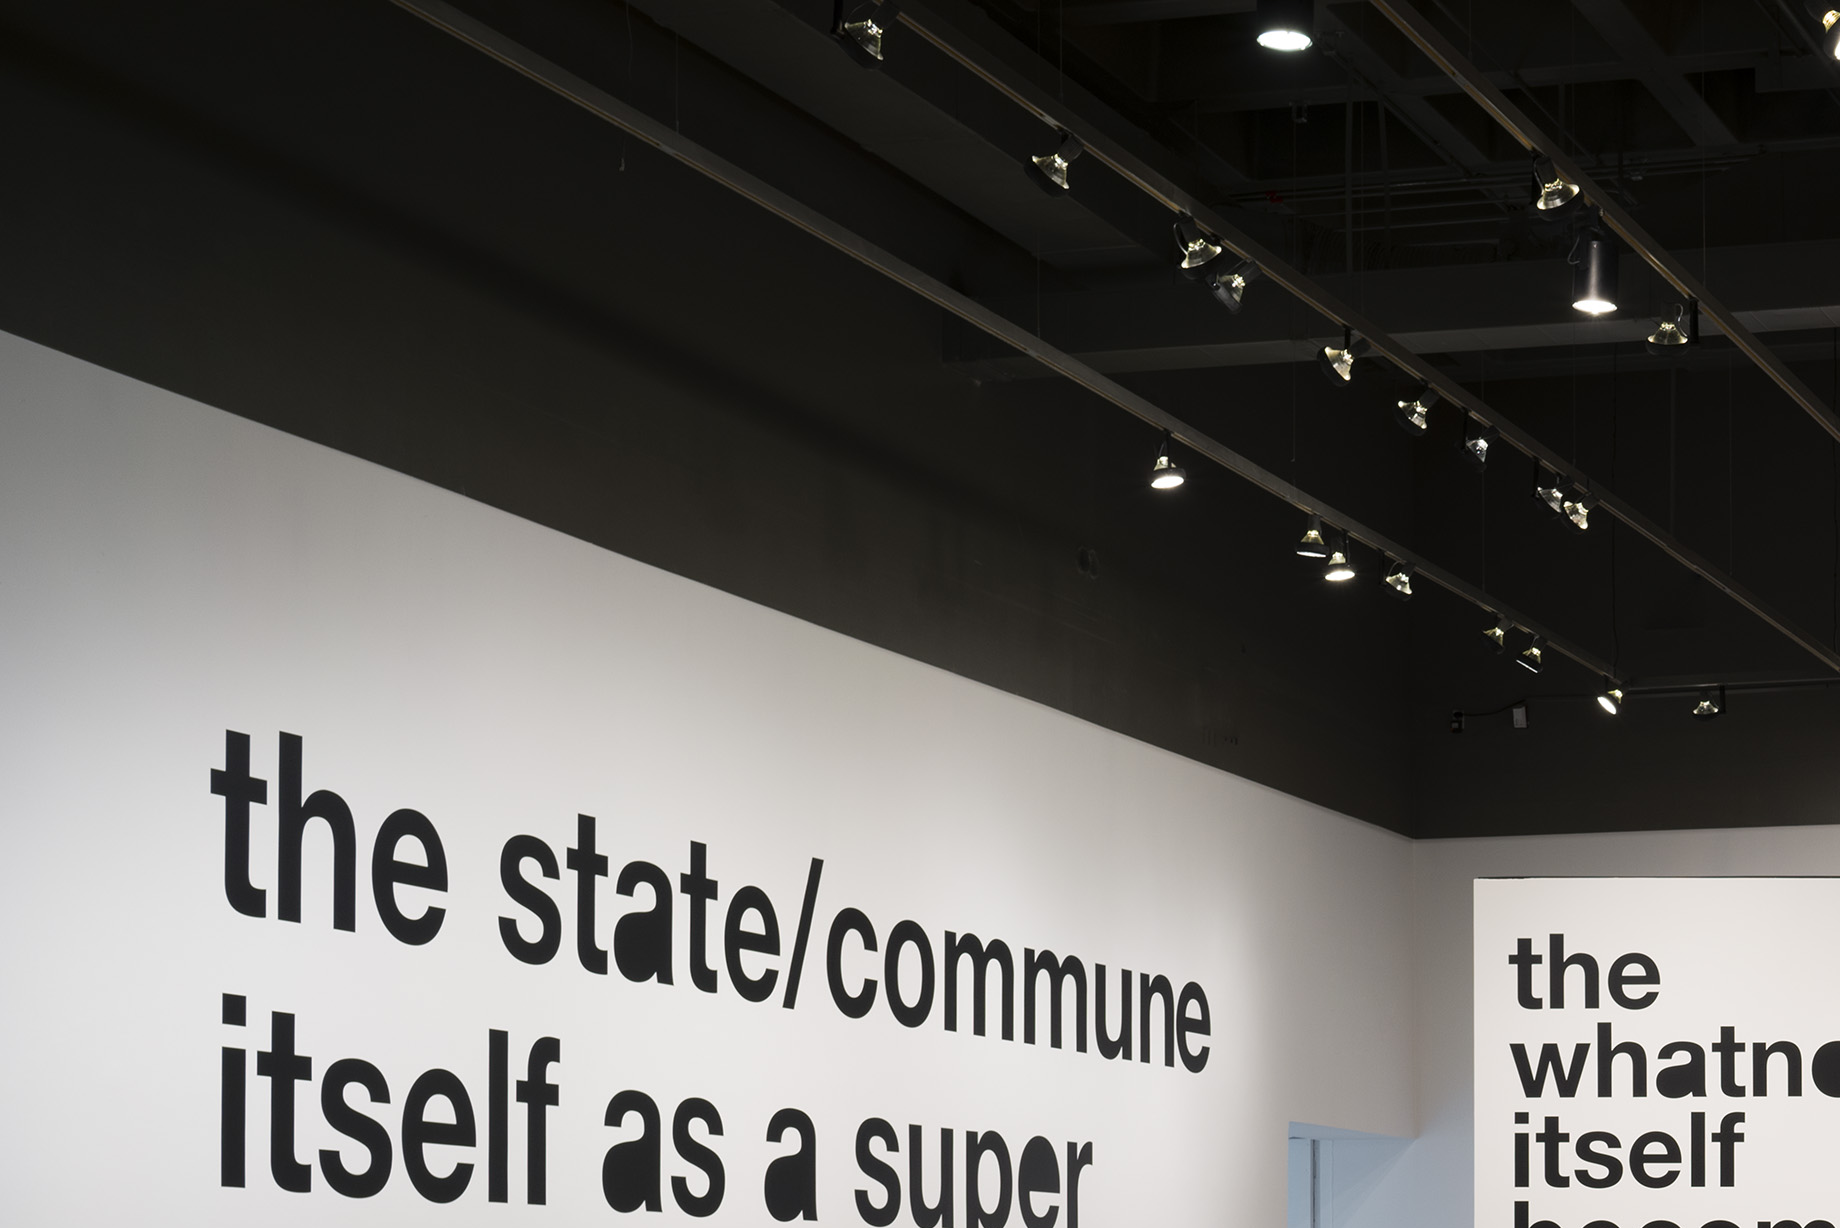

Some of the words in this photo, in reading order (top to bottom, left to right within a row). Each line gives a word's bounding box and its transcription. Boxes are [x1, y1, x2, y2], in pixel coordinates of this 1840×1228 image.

[210, 729, 448, 946] the
[498, 813, 1211, 1074] state/commune
[1508, 933, 1661, 1010] the
[221, 993, 561, 1206] itself
[602, 1089, 726, 1218] as
[764, 1108, 818, 1222] a
[1514, 1111, 1746, 1189] itself
